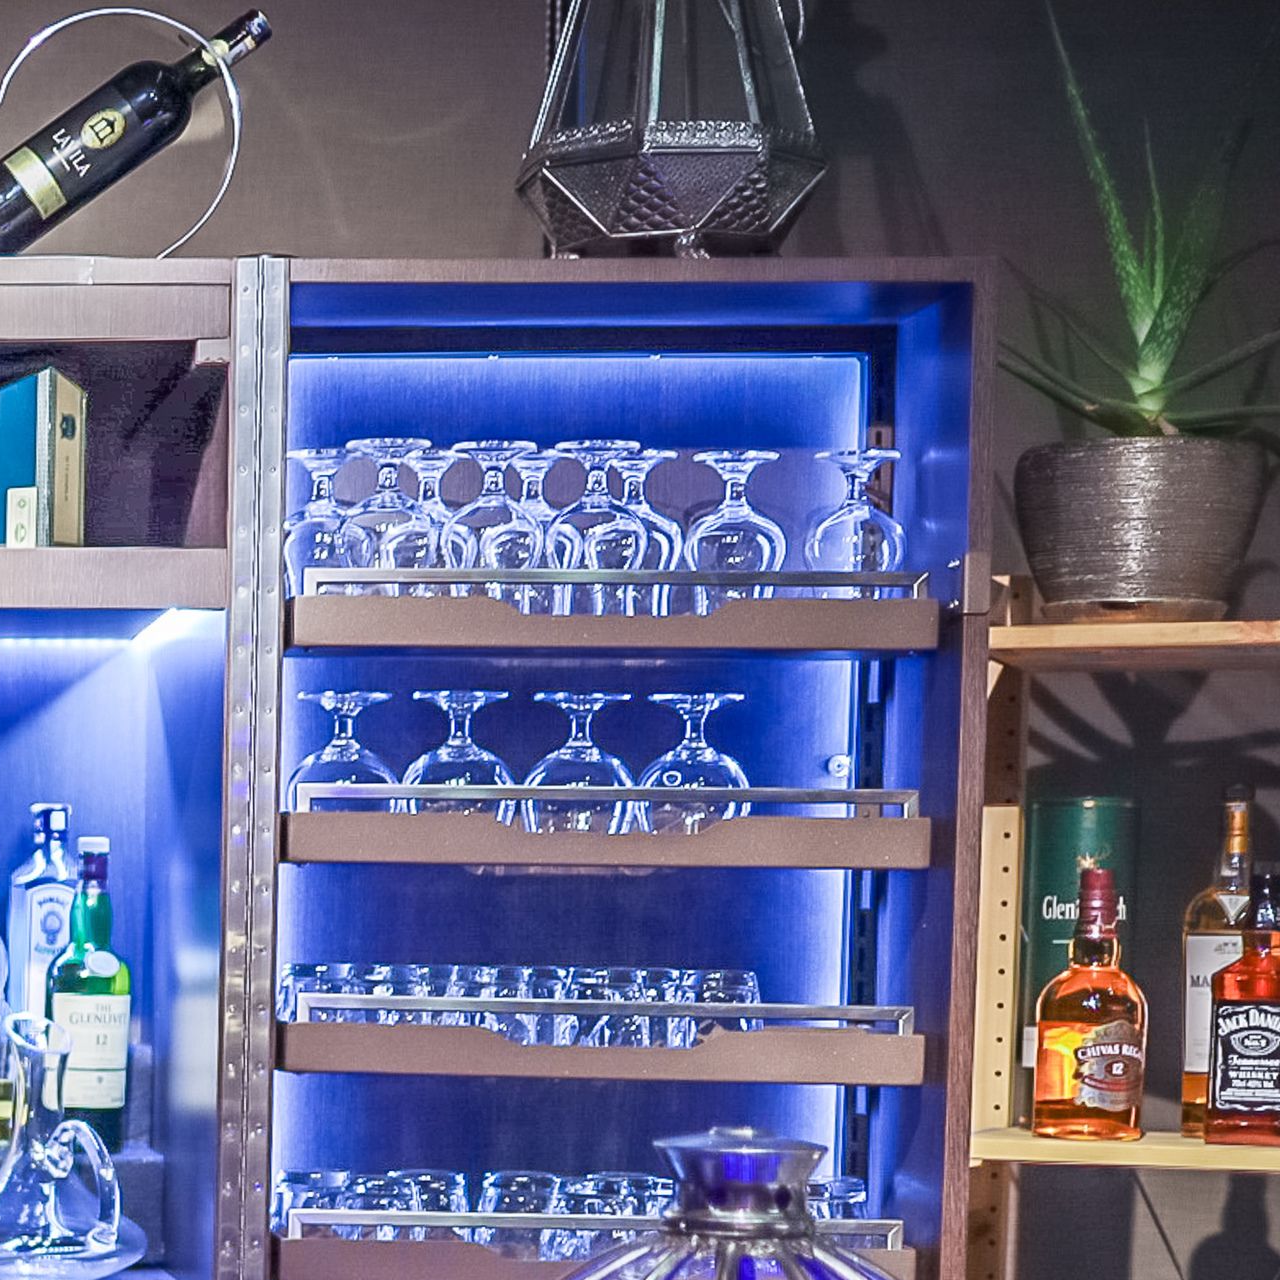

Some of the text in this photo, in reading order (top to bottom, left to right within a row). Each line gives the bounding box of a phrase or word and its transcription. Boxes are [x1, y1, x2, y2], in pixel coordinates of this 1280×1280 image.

[1218, 1013, 1248, 1036] JACK
[96, 1033, 108, 1046] 12
[1077, 1043, 1120, 1061] CHIVAS
[1228, 1070, 1279, 1080] WHISKEY
